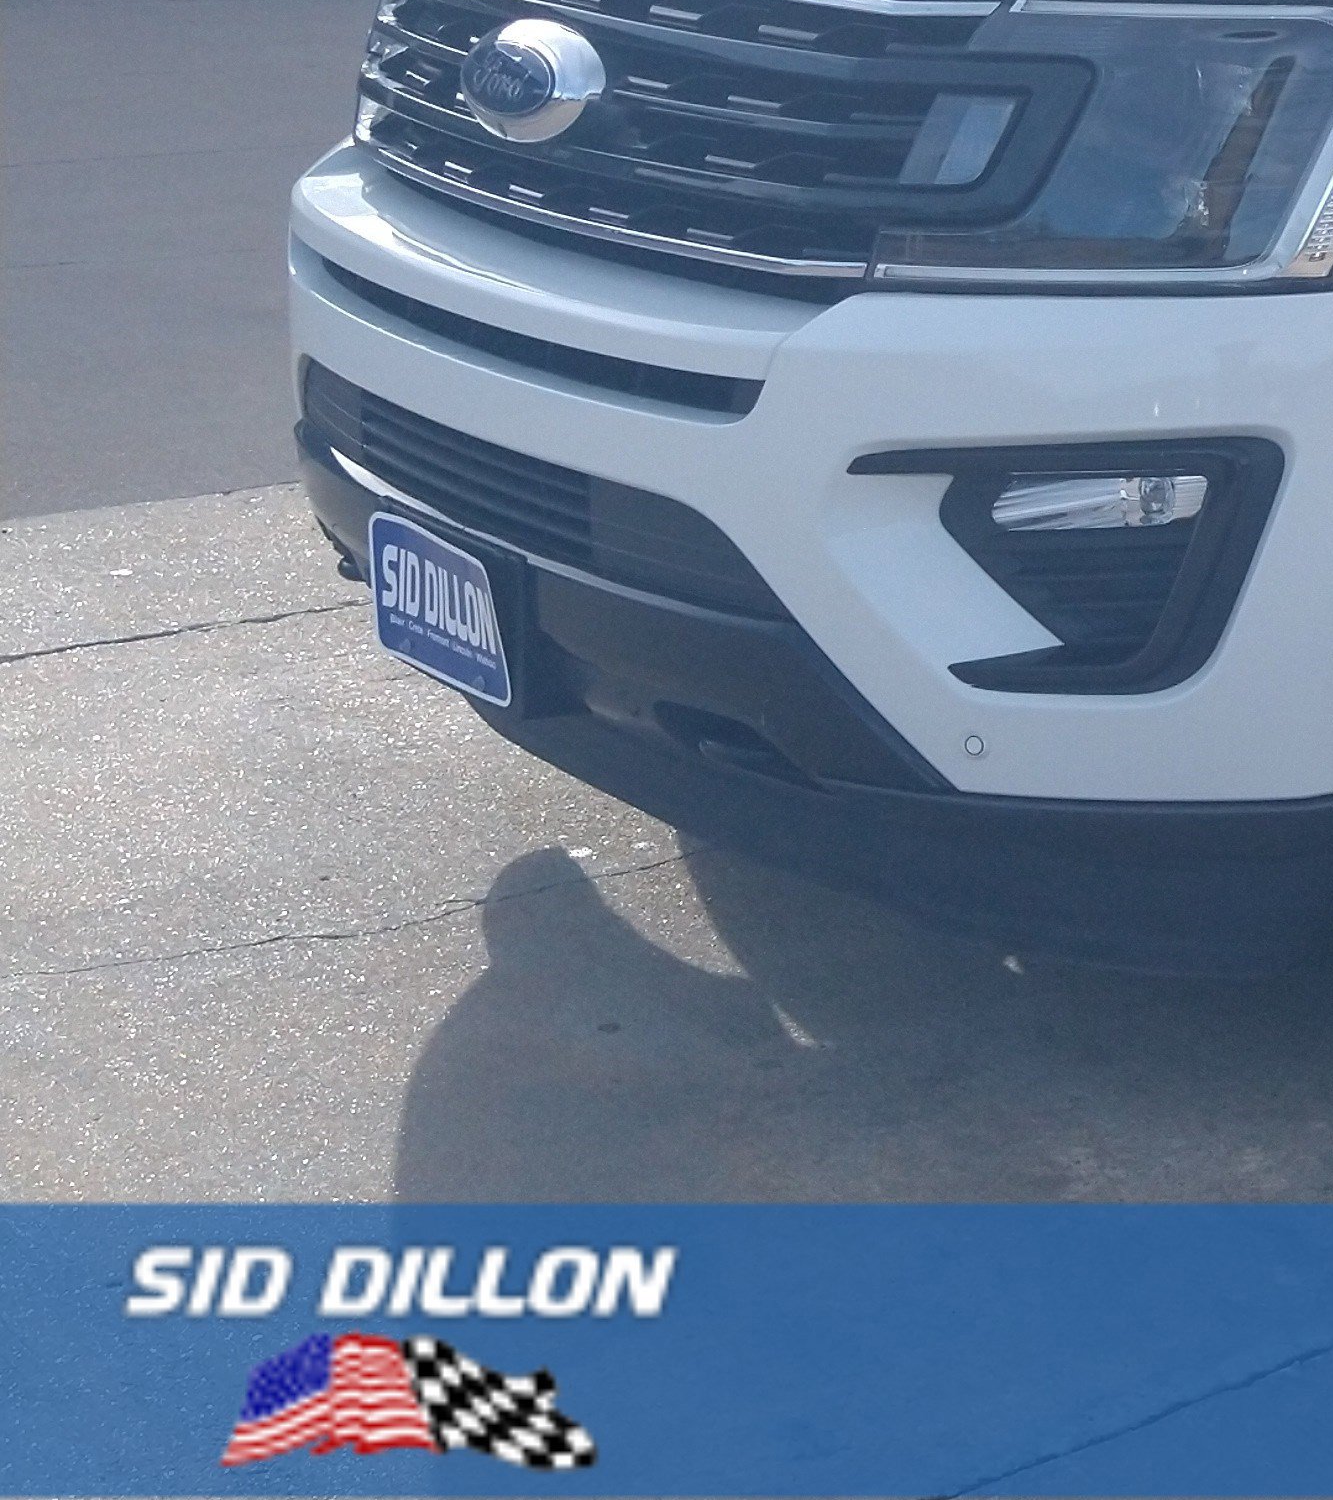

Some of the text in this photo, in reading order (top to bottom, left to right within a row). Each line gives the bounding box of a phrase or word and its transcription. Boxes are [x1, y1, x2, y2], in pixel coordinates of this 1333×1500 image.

[473, 49, 532, 101] Ford
[381, 544, 497, 656] SID DILLON
